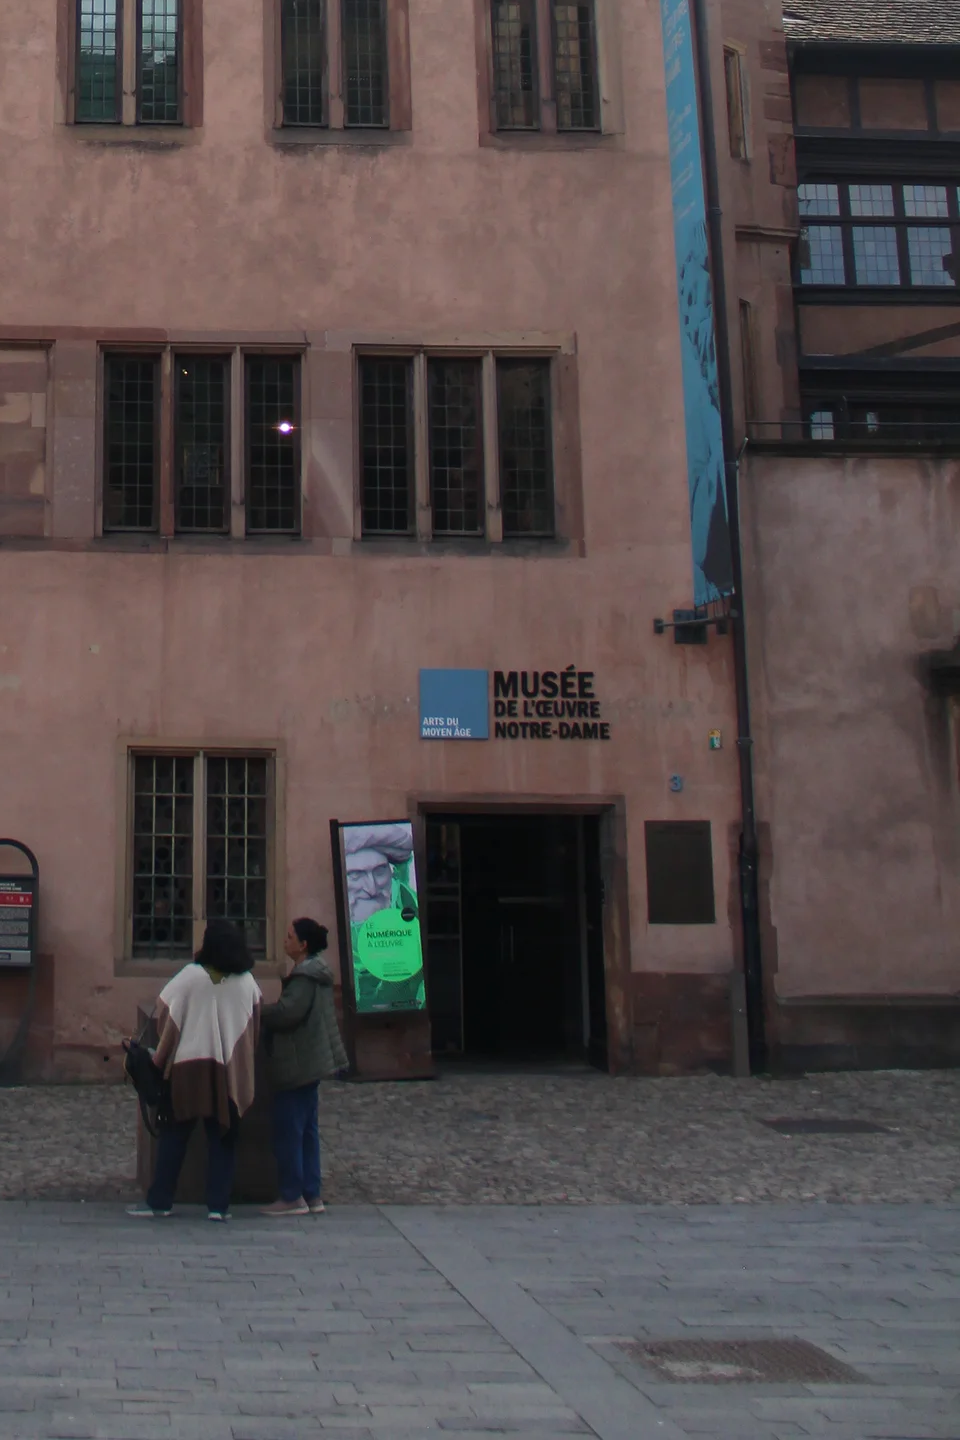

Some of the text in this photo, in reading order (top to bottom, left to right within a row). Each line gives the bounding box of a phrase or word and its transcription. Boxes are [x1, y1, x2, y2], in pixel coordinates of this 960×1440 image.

[494, 664, 594, 698] MUSÉE
[494, 700, 600, 718] DE L'ŒUVRE
[423, 717, 459, 726] ARTS DU
[422, 725, 471, 737] MOYEN ÂGE
[495, 721, 611, 740] NOTRE-DAME
[670, 773, 681, 791] 3
[366, 922, 374, 930] LE
[366, 929, 412, 939] NUMÉRIQUE
